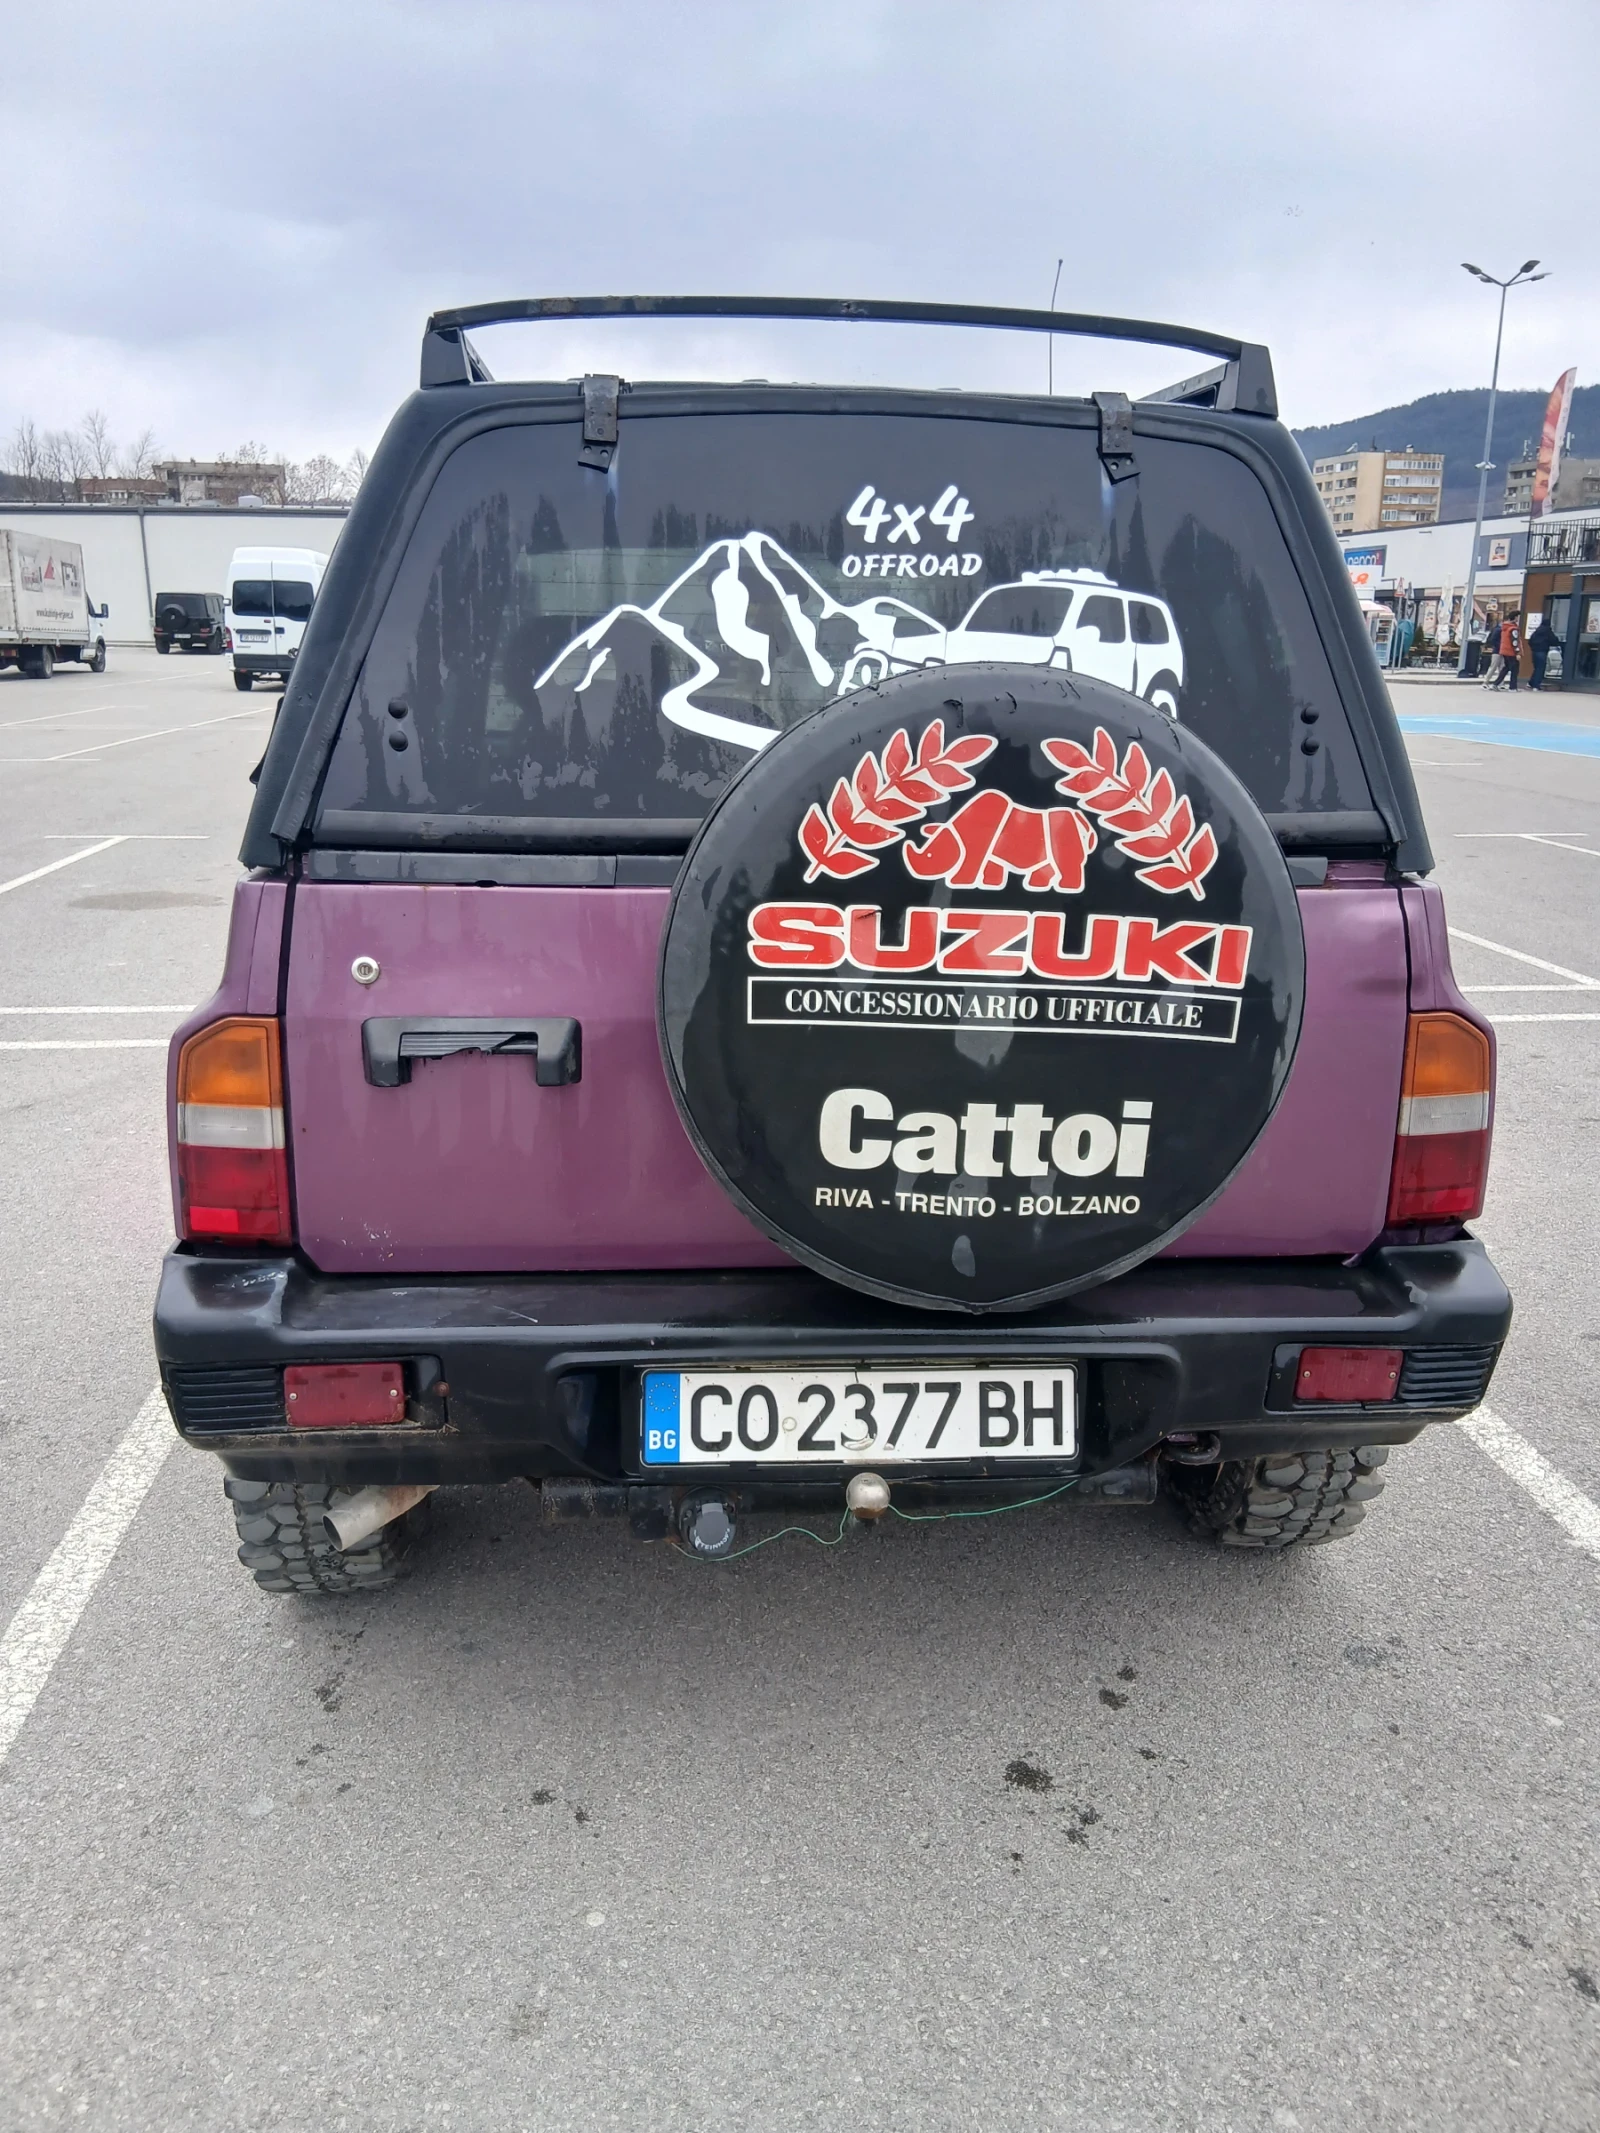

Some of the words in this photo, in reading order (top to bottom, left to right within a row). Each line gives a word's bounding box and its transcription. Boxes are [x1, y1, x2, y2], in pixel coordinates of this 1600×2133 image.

[845, 485, 975, 545] 4x4
[841, 553, 983, 579] OFFROAD
[746, 901, 1255, 991] SUZUKI
[784, 988, 1038, 1021] CONCESSIONARIO
[1046, 997, 1204, 1029] UFFICIALE
[819, 1088, 1154, 1178] Cattoi
[815, 1187, 874, 1209] RIVA
[894, 1191, 997, 1219] TRENTO
[1018, 1193, 1141, 1217] BOLZANO
[648, 1429, 677, 1451] BG
[690, 1384, 779, 1453] CO
[796, 1381, 962, 1452] 2377
[978, 1380, 1064, 1449] BH
